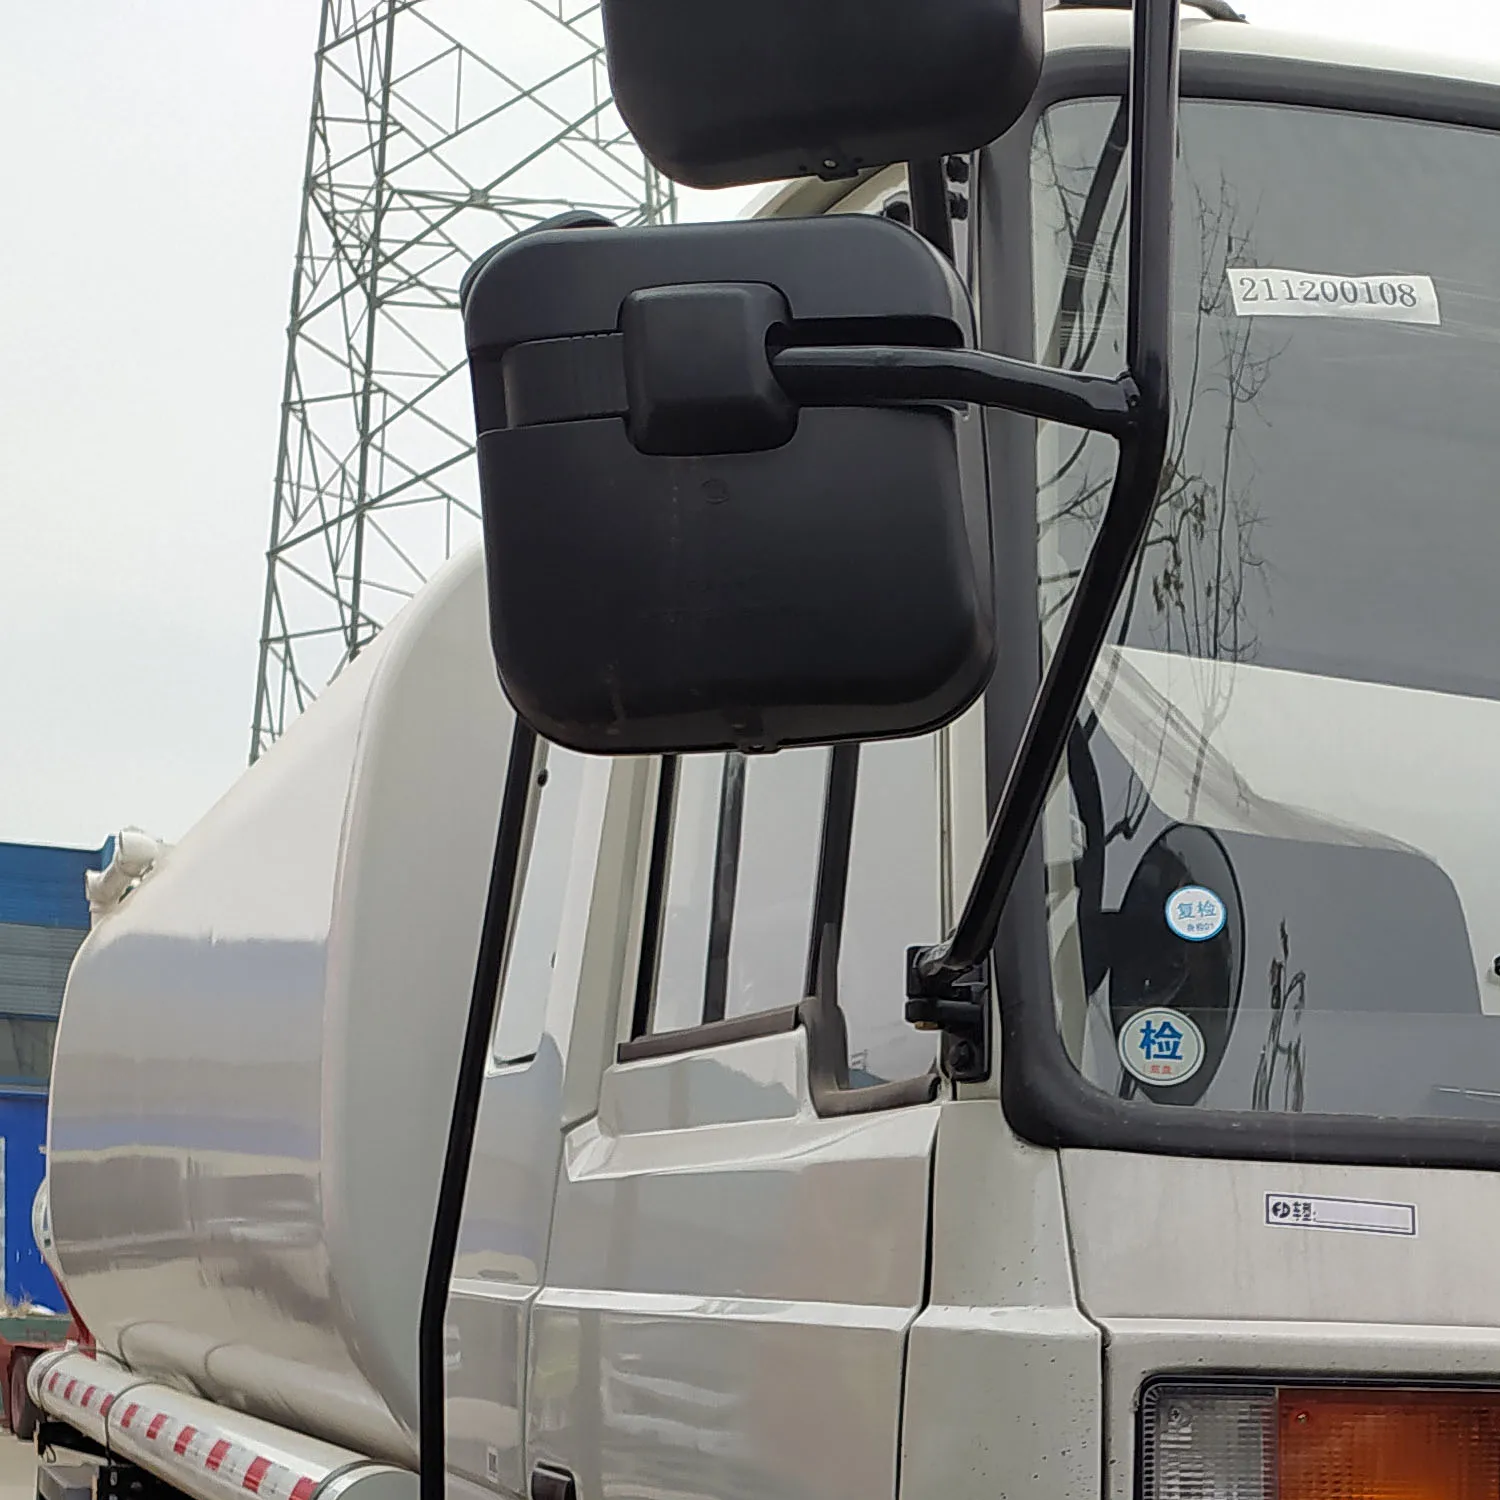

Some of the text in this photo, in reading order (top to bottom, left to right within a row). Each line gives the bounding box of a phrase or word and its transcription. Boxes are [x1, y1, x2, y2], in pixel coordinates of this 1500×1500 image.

[1239, 276, 1418, 308] 211200108
[1176, 900, 1217, 920] 复检
[1138, 1019, 1184, 1060] 检
